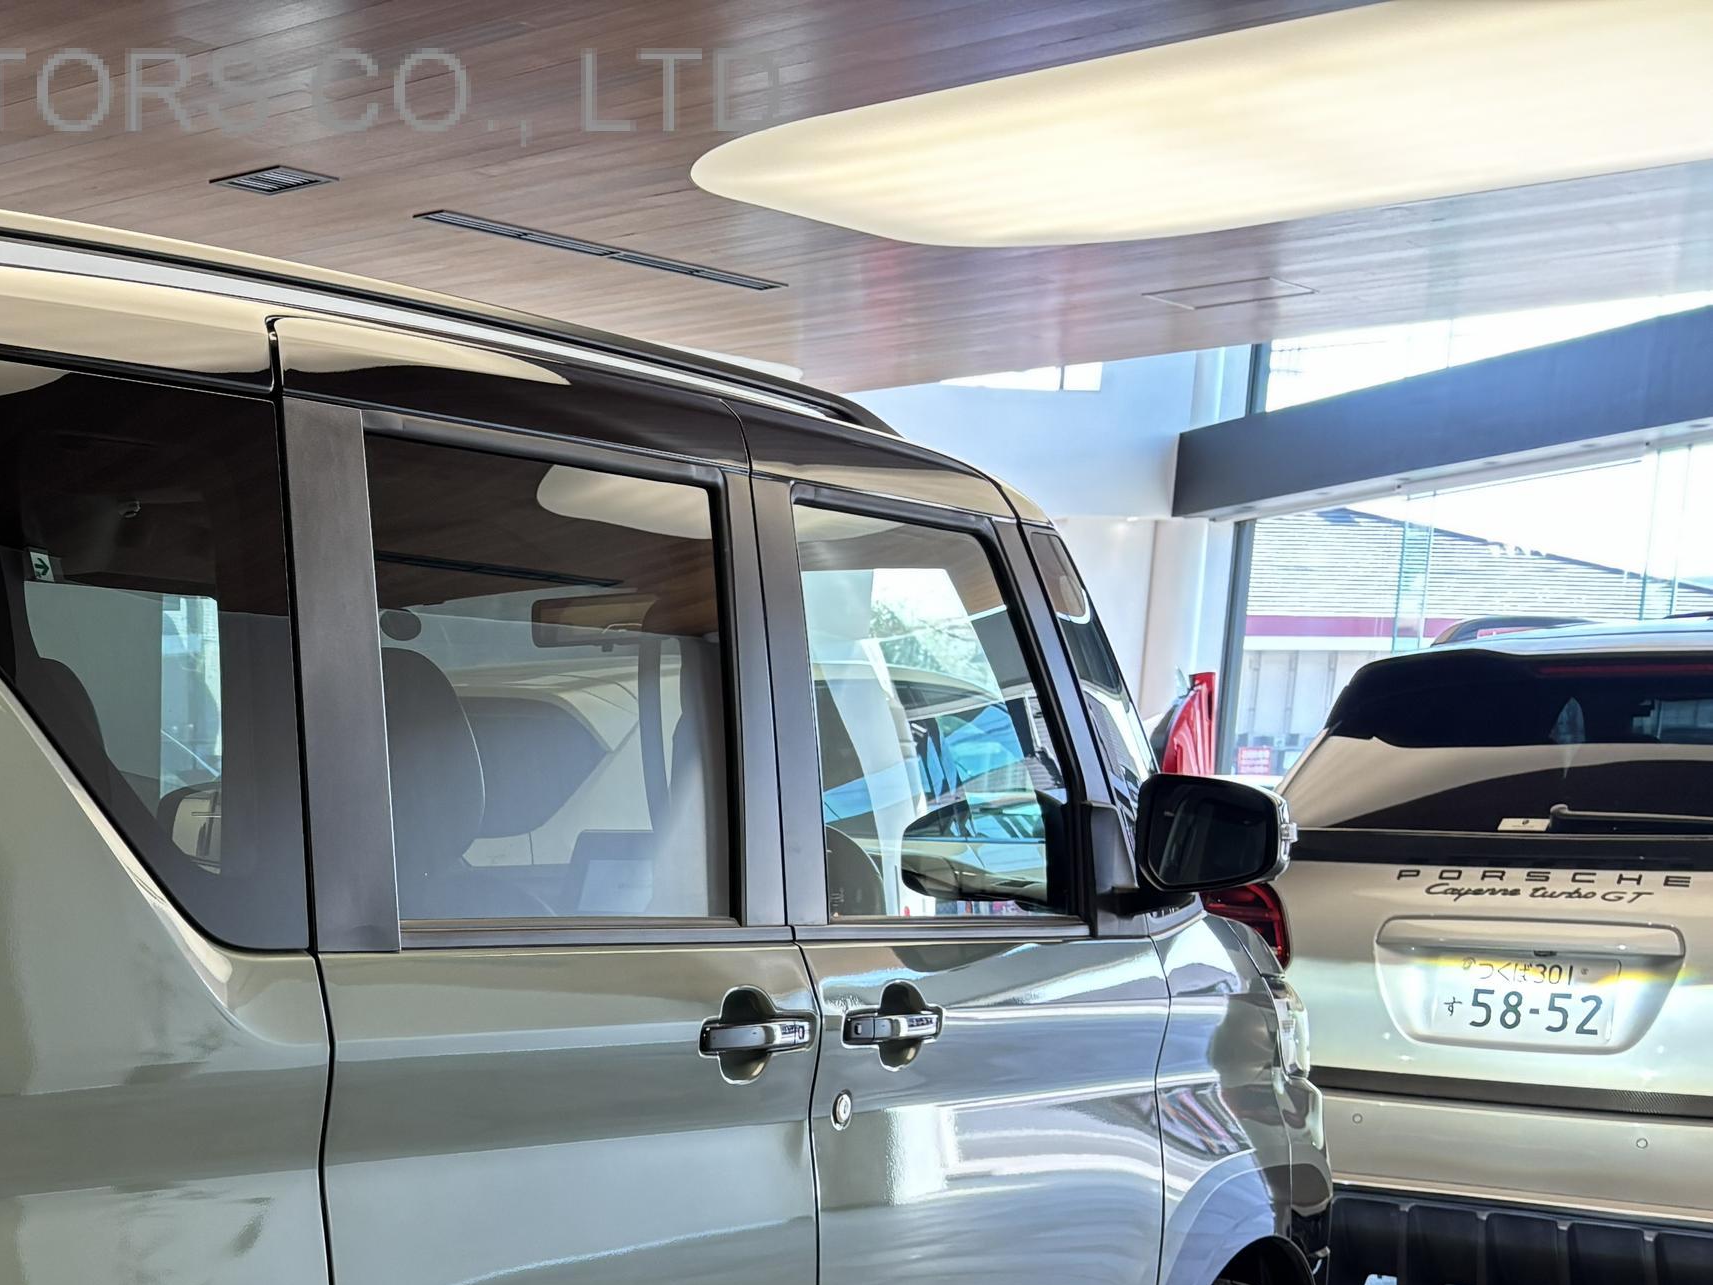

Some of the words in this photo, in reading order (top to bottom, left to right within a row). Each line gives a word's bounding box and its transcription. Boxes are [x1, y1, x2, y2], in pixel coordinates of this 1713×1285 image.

[1396, 868, 1692, 888] PORSCHE
[1425, 882, 1521, 902] Cayenne
[1528, 886, 1597, 900] turbo
[1600, 890, 1655, 904] GT
[1443, 996, 1463, 1016] す
[1469, 988, 1604, 1036] 58-52
